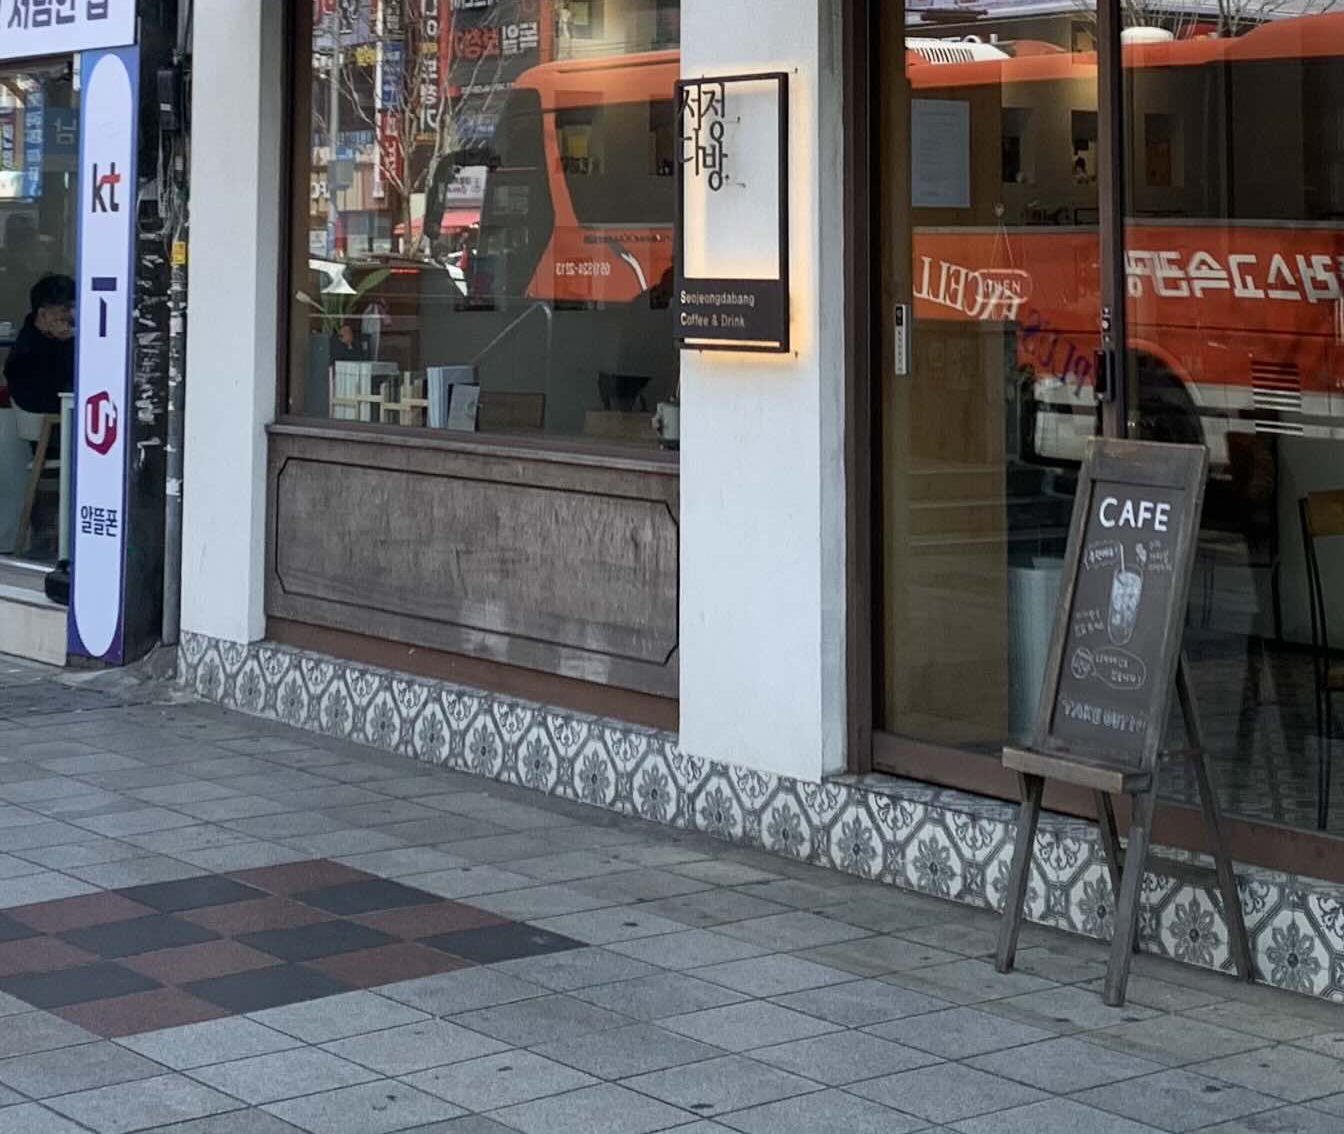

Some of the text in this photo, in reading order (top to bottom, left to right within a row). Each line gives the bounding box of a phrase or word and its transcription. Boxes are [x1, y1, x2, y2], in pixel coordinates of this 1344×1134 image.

[91, 162, 121, 215] kt
[680, 288, 755, 308] Seojeongdabang
[680, 312, 709, 328] Coffee
[721, 313, 746, 329] Drink
[80, 504, 118, 539] 알뜰폰
[1099, 497, 1172, 533] CAFE
